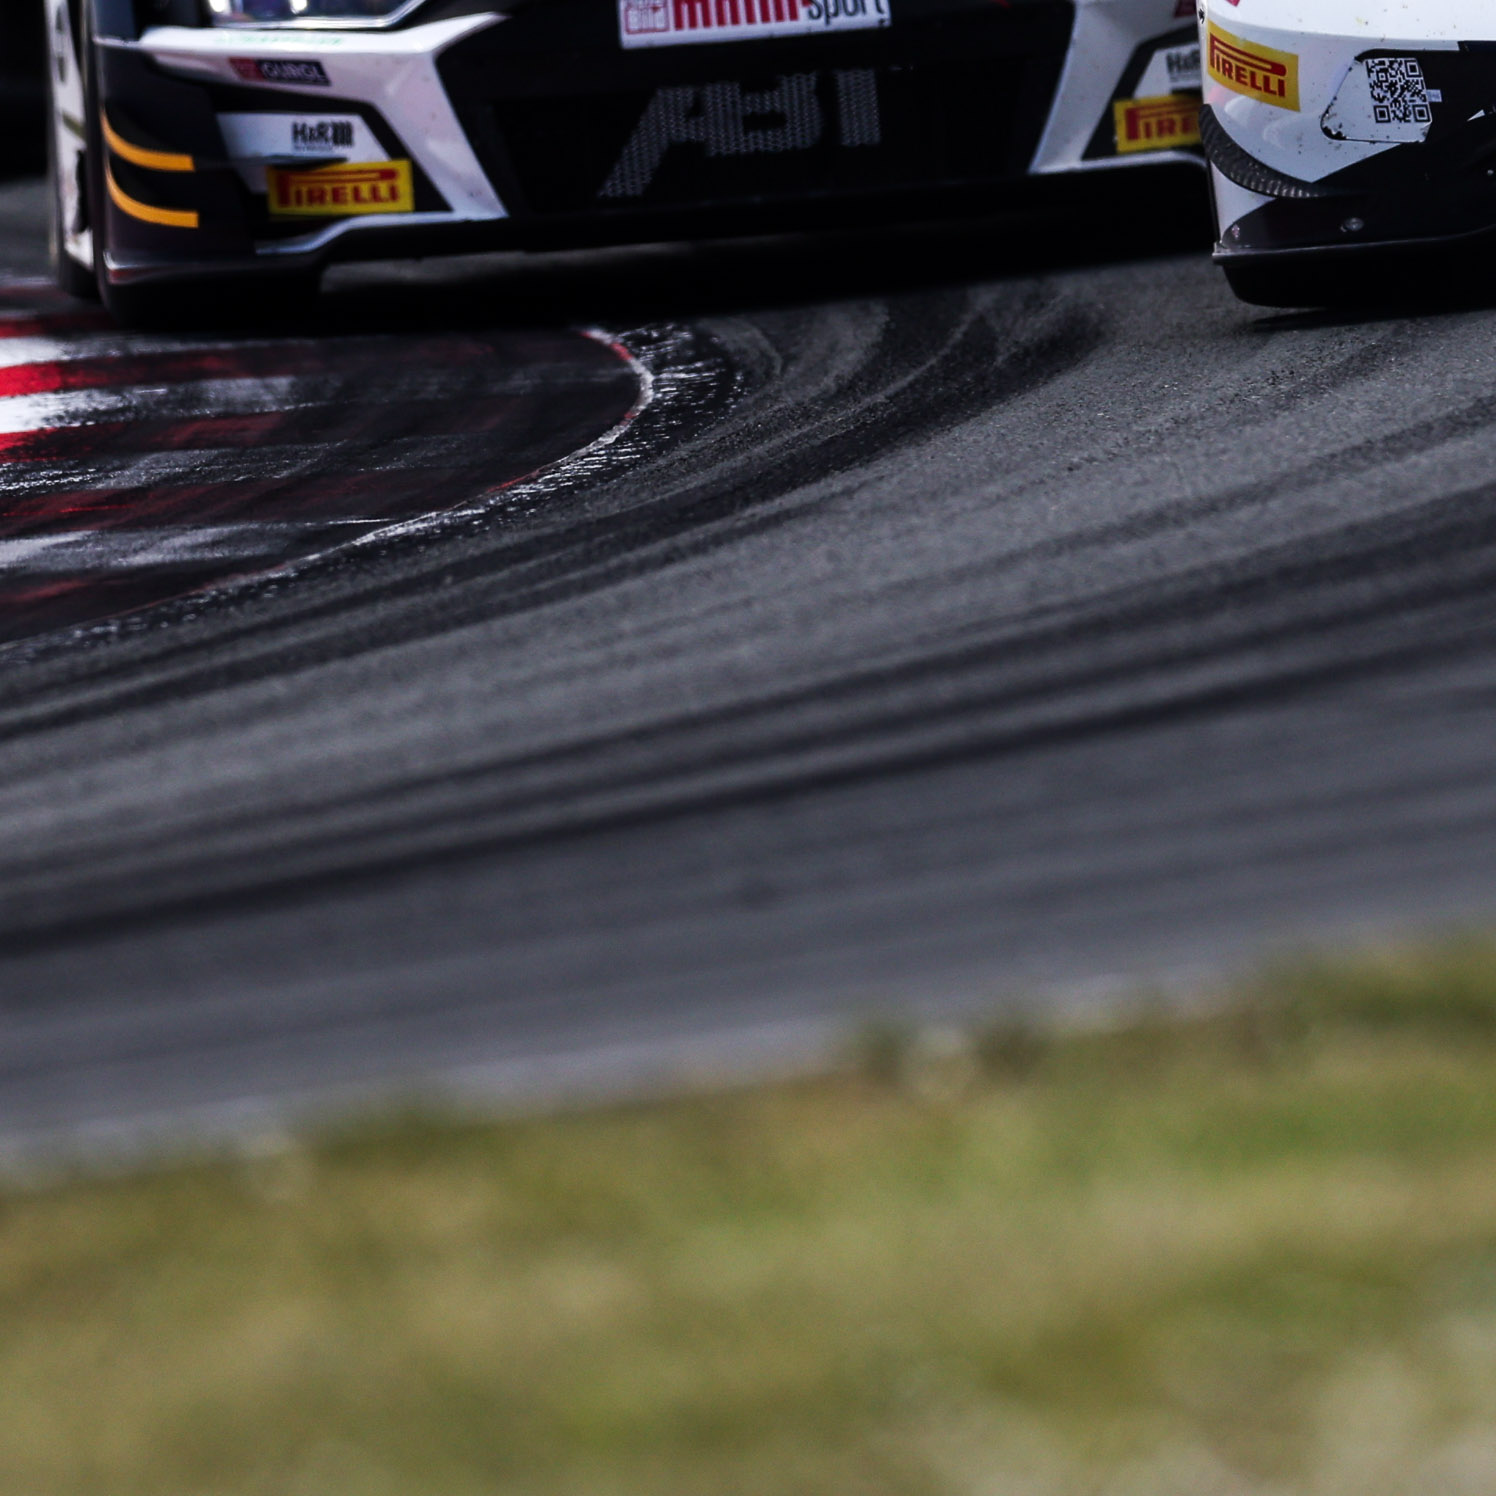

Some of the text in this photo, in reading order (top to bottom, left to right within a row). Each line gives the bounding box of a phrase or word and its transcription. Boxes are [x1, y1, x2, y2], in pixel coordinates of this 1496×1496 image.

[1209, 32, 1288, 98] PIRELLI
[600, 68, 882, 198] ABT
[1125, 106, 1201, 142] PIRE
[276, 168, 399, 209] PIRELLI
